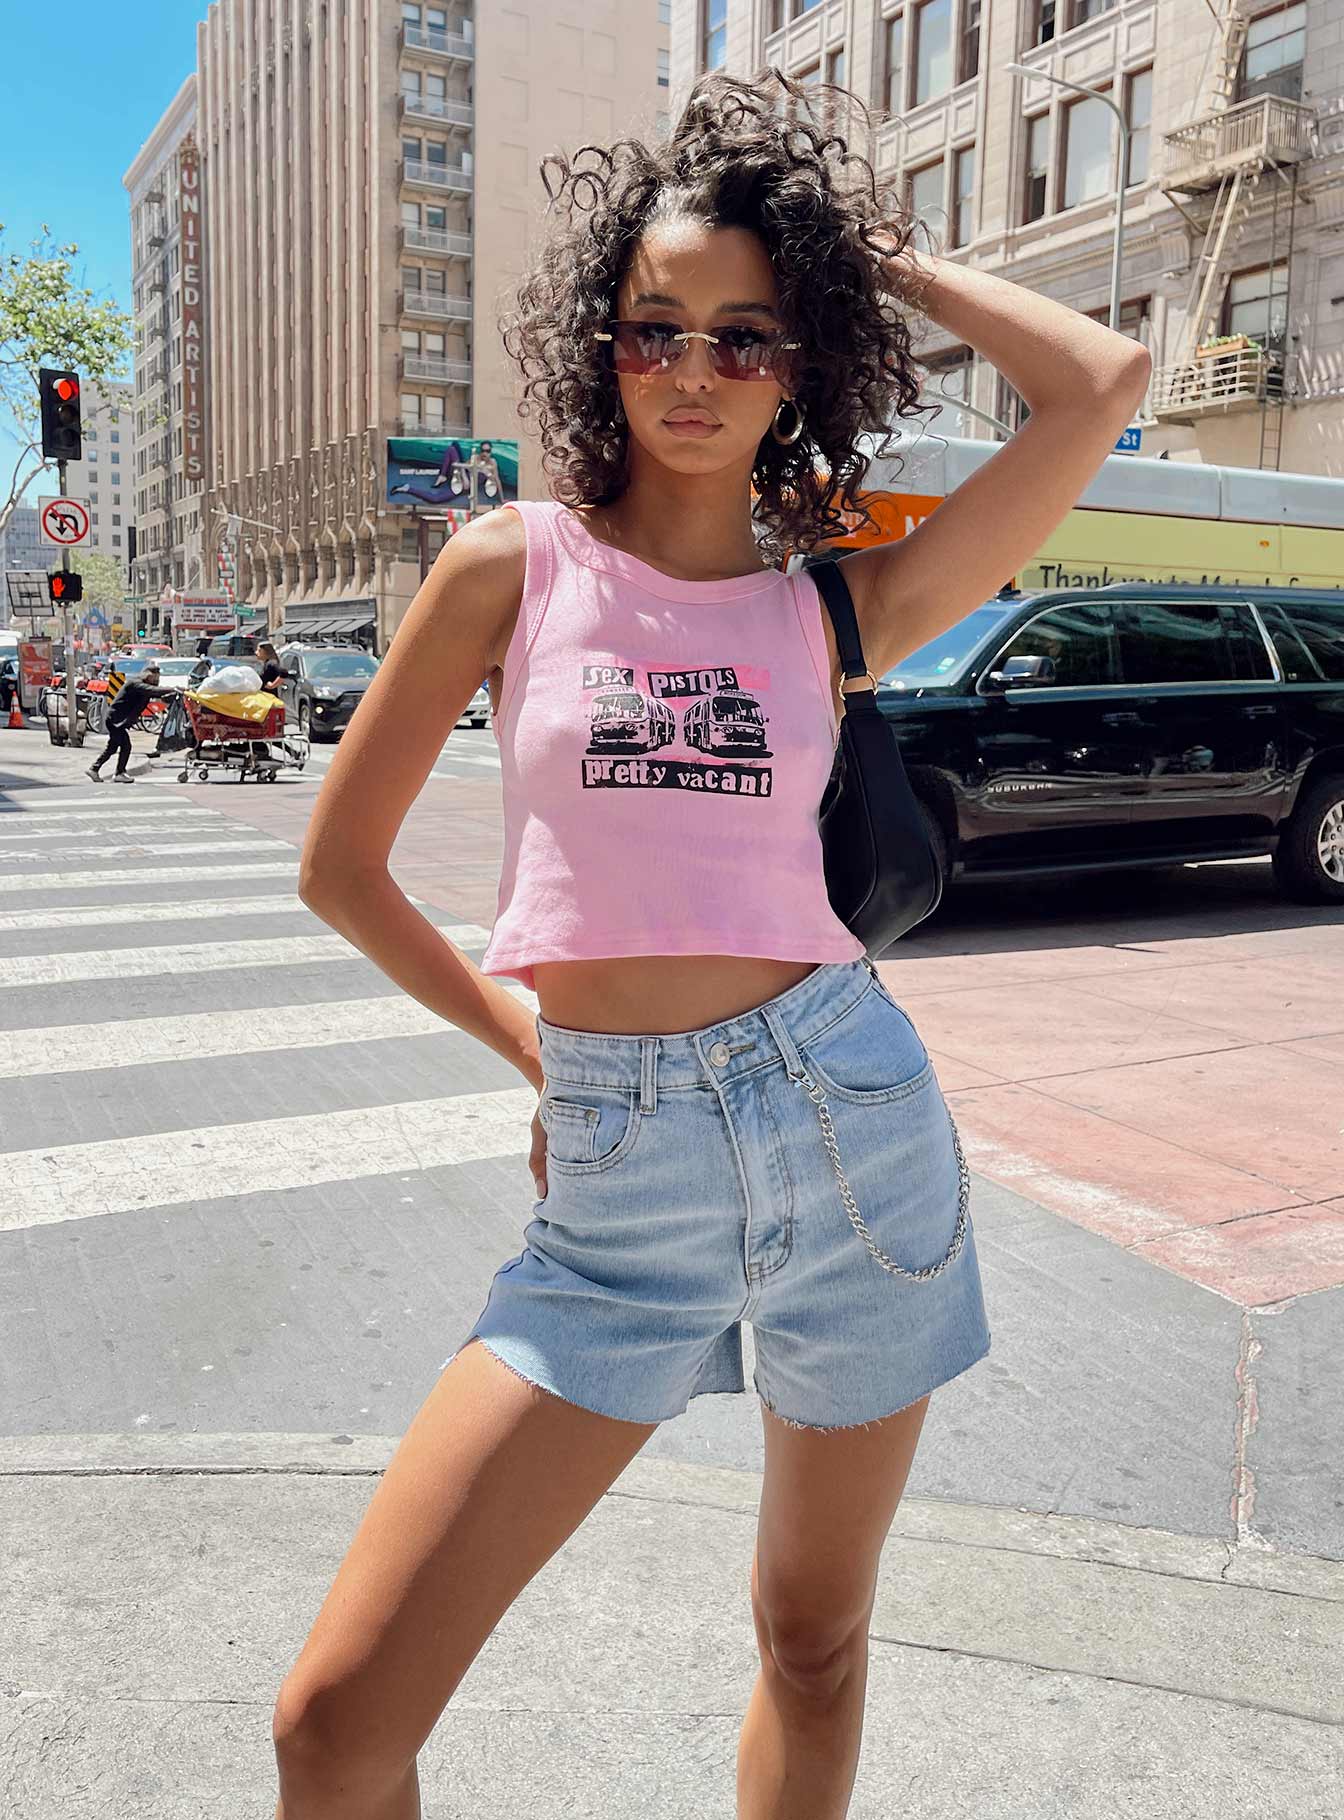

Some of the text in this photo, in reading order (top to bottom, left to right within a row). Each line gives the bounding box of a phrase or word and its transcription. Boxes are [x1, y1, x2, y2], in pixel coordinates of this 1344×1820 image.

[182, 170, 202, 475] UNITED ARTISTS
[1122, 432, 1138, 446] St
[1039, 563, 1114, 588] Thank
[584, 759, 771, 796] pretty vacant
